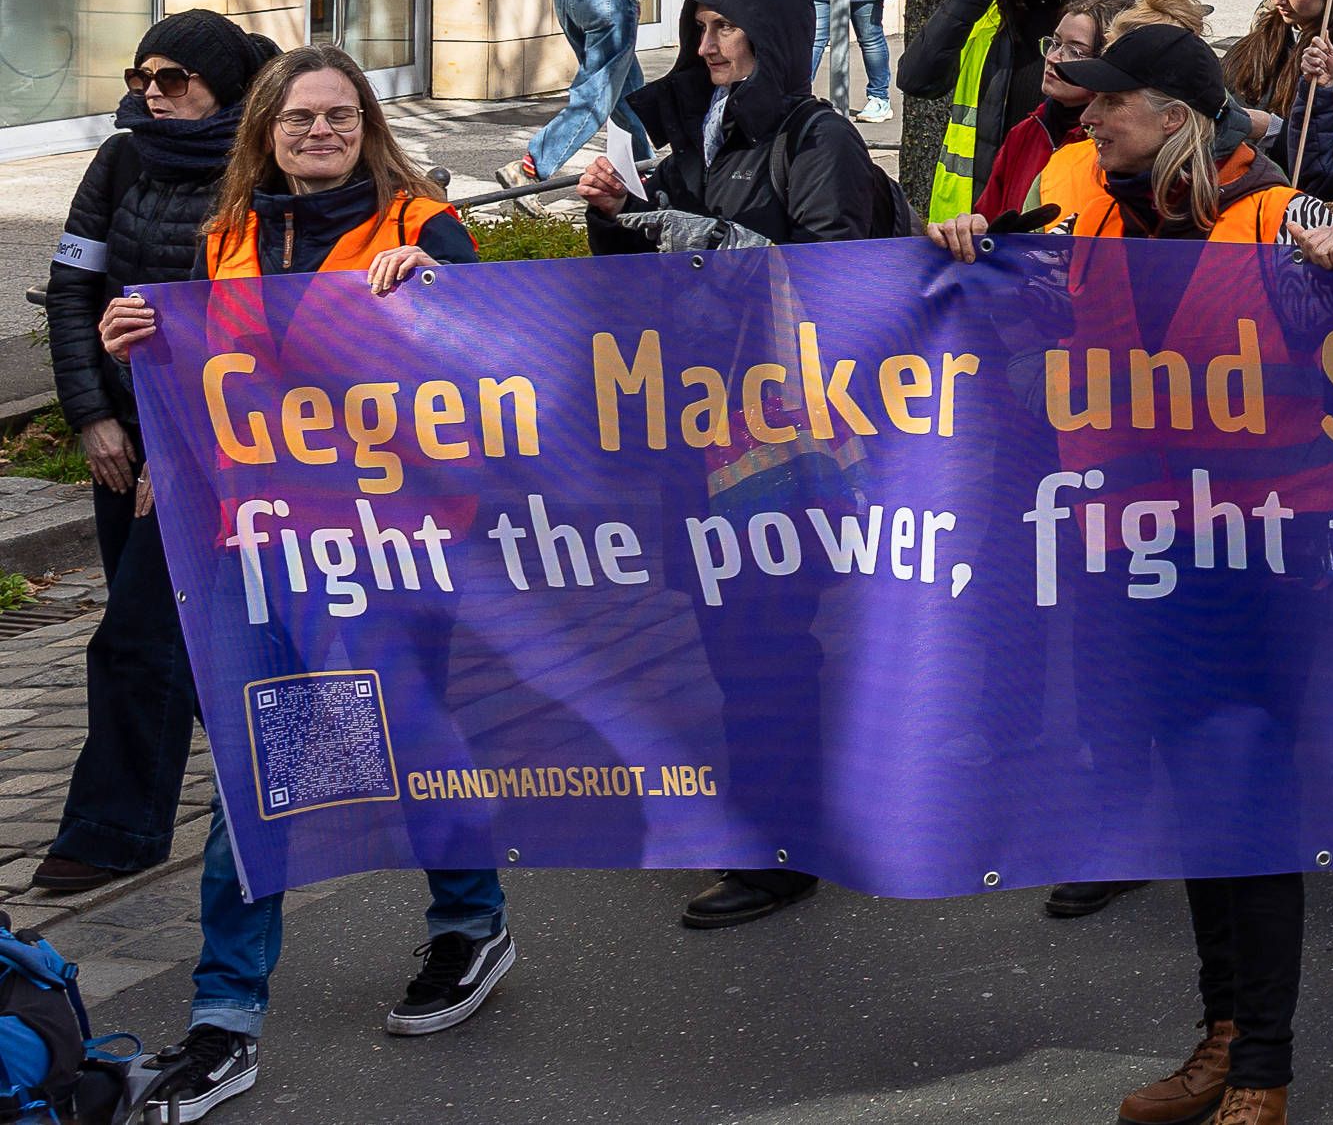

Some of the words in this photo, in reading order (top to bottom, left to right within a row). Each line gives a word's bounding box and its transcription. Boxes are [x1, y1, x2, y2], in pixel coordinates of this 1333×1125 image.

[203, 352, 540, 495] Gegen
[592, 322, 980, 452] Macker
[1045, 318, 1266, 434] und
[226, 497, 454, 625] fight
[488, 494, 649, 592] the
[686, 505, 973, 607] power,
[1023, 468, 1294, 607] fight
[407, 764, 717, 803] @HANDMAIDSRIOT_NBG
